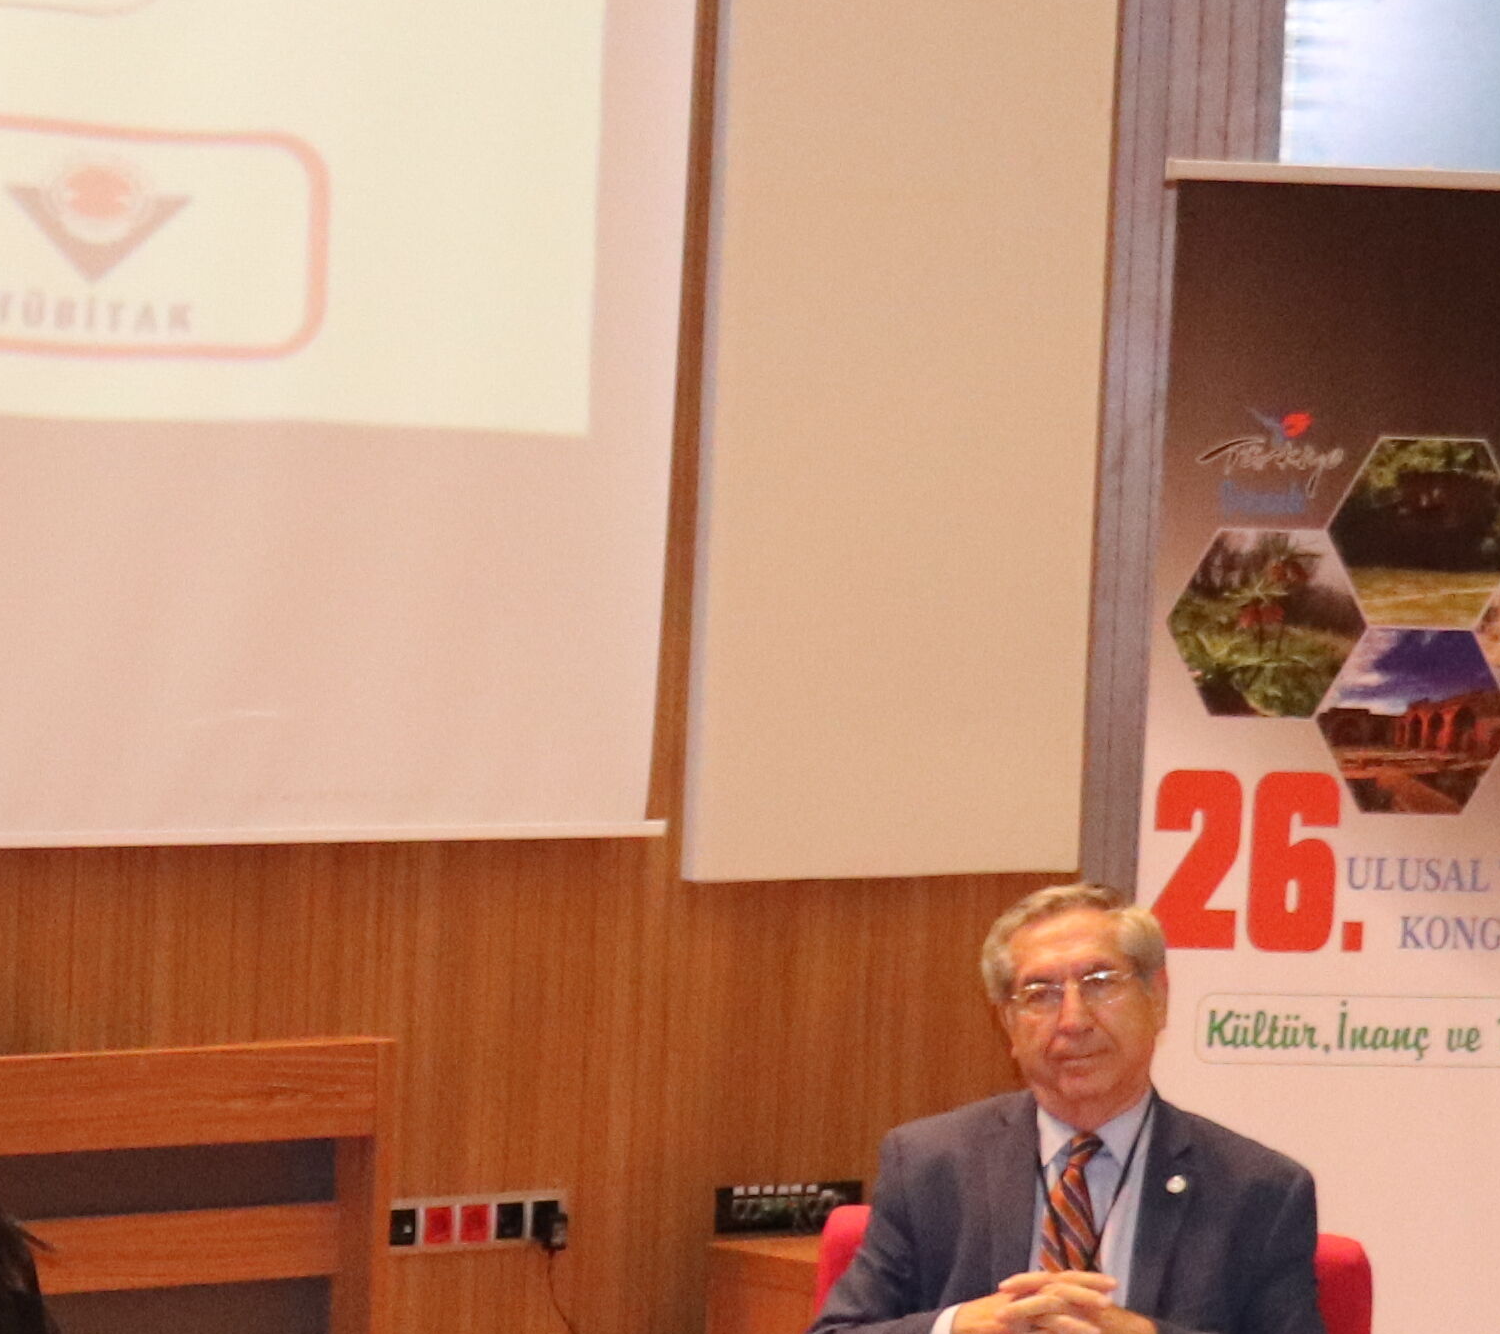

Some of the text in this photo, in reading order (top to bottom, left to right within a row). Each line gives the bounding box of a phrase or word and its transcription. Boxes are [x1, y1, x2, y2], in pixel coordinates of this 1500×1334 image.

[1153, 769, 1364, 954] 26.
[1345, 856, 1491, 893] ULUSAL
[1446, 1025, 1482, 1053] ve
